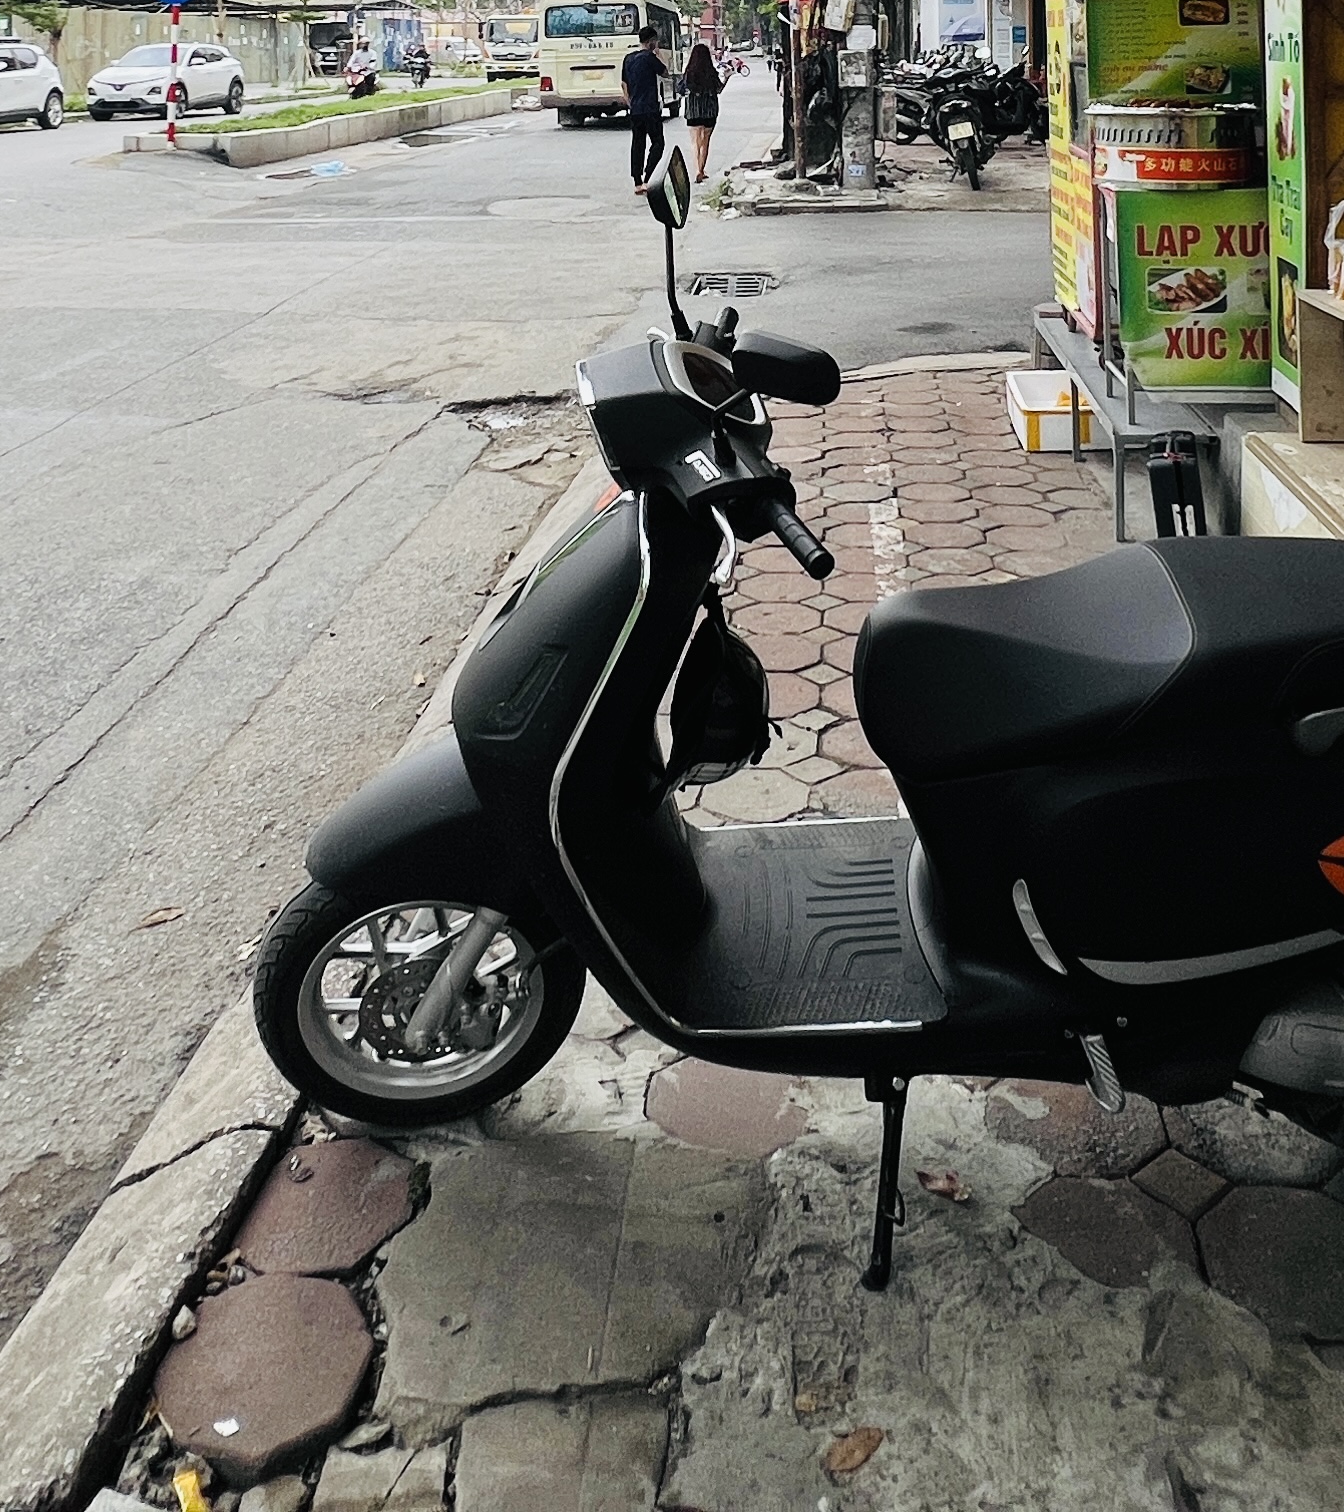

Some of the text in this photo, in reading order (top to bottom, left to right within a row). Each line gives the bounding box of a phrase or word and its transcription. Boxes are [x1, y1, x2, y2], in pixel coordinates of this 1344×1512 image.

[1144, 156, 1242, 173] 多功能火山石
[1136, 221, 1270, 265] LẠP XƯ
[1165, 320, 1227, 360] XÚC
